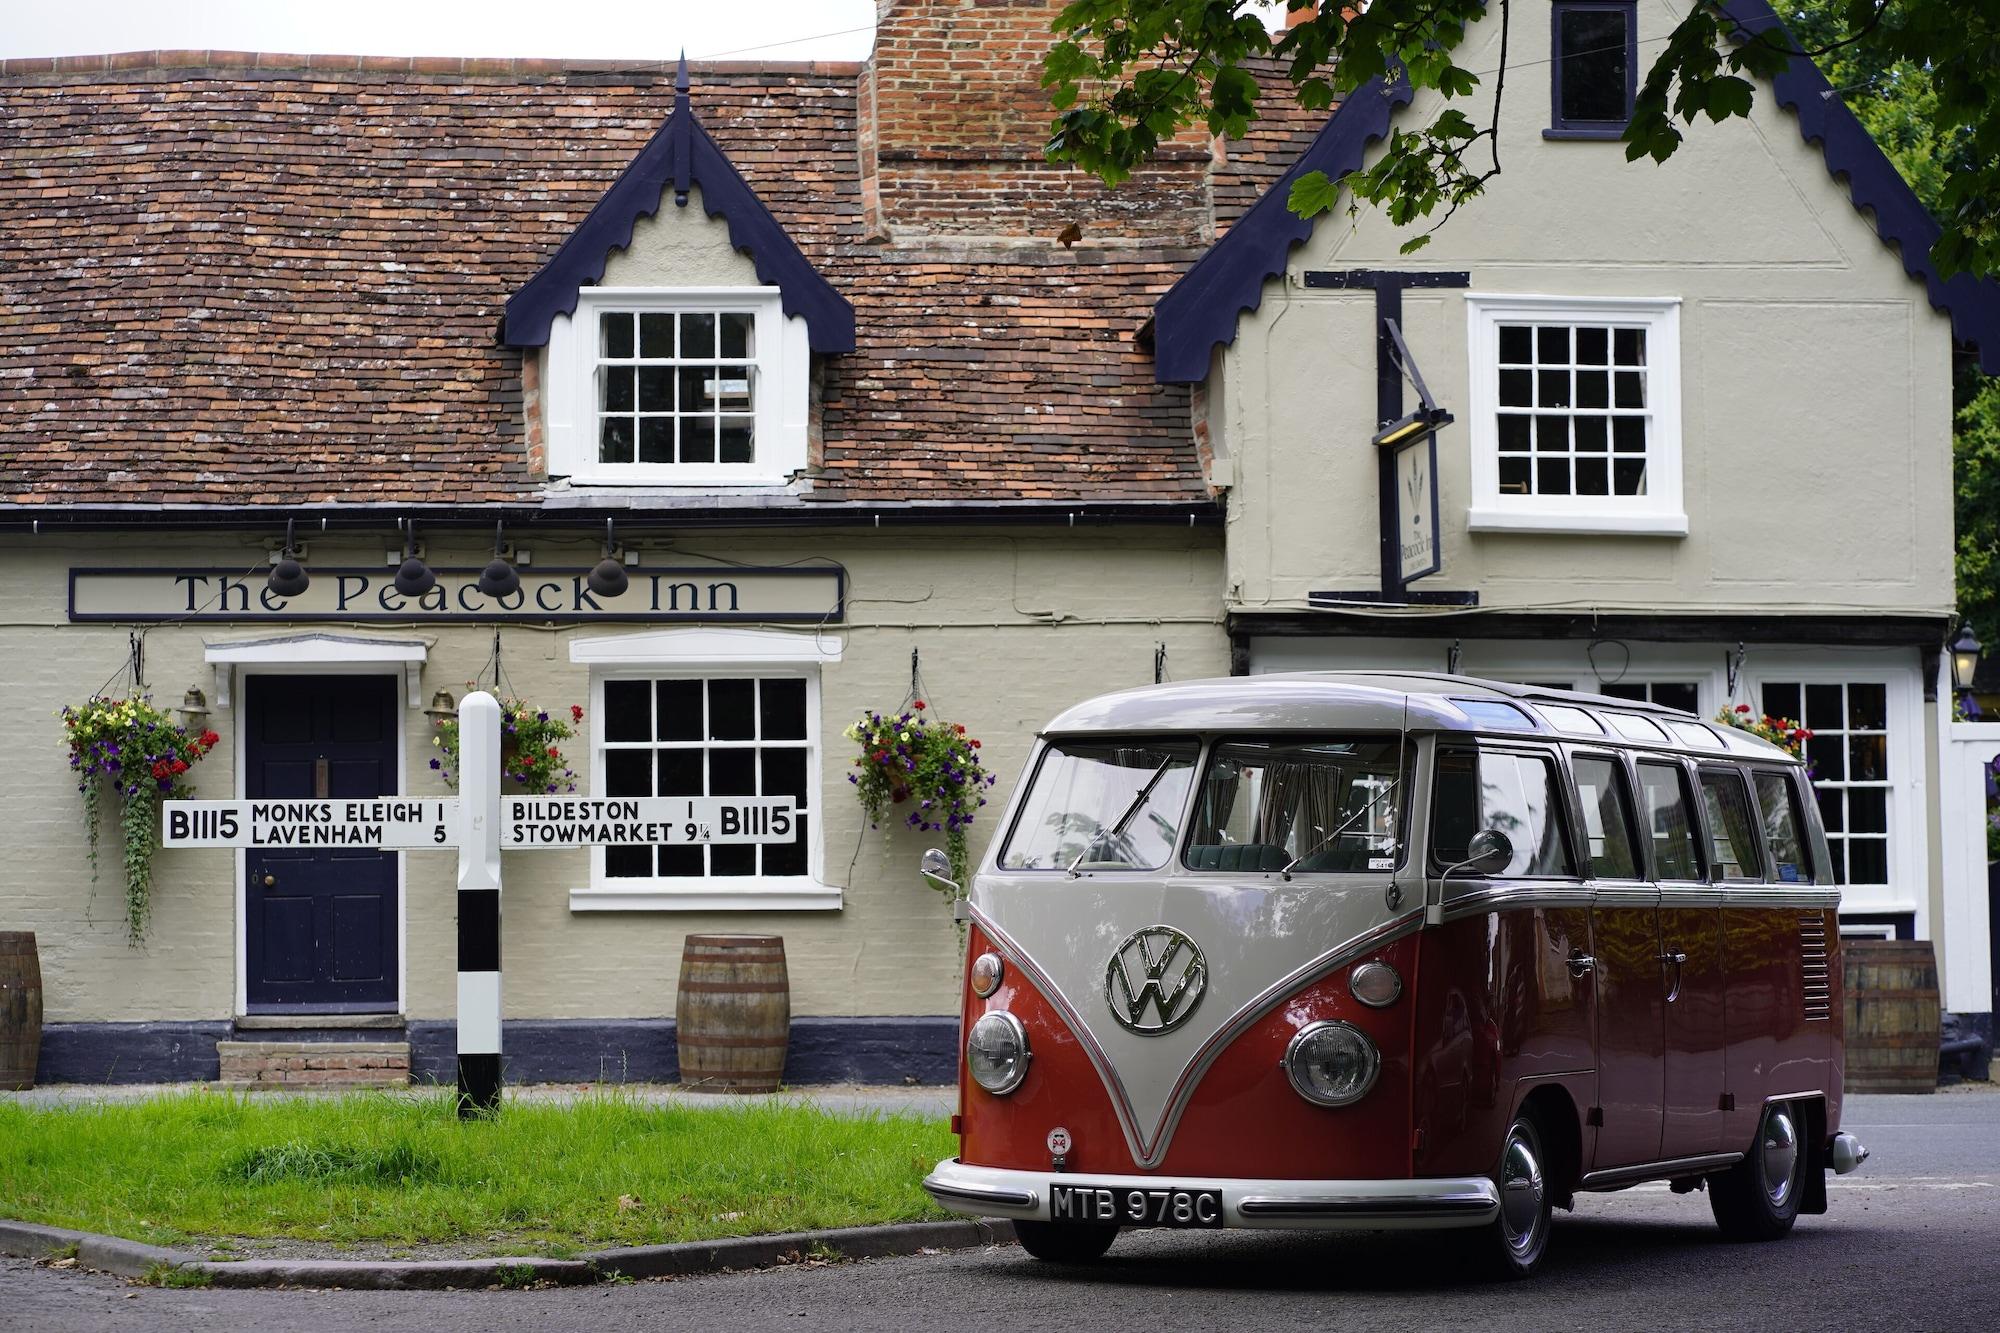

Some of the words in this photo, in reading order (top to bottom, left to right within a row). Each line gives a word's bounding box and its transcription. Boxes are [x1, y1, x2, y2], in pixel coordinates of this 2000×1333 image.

[174, 575, 289, 612] The
[335, 575, 605, 612] Peacock
[649, 575, 740, 611] Inn
[169, 809, 239, 840] B1115
[252, 804, 332, 822] MONKS
[346, 803, 422, 822] ELEIGH
[512, 801, 639, 820] BILDESTON
[720, 805, 790, 835] B1115
[252, 825, 382, 844] LAVENHAM
[433, 825, 446, 843] 5
[512, 822, 673, 842] STOWMARKET
[1105, 926, 1205, 1034] VW
[1053, 1187, 1117, 1219] MTB
[1127, 1190, 1217, 1223] 978C
